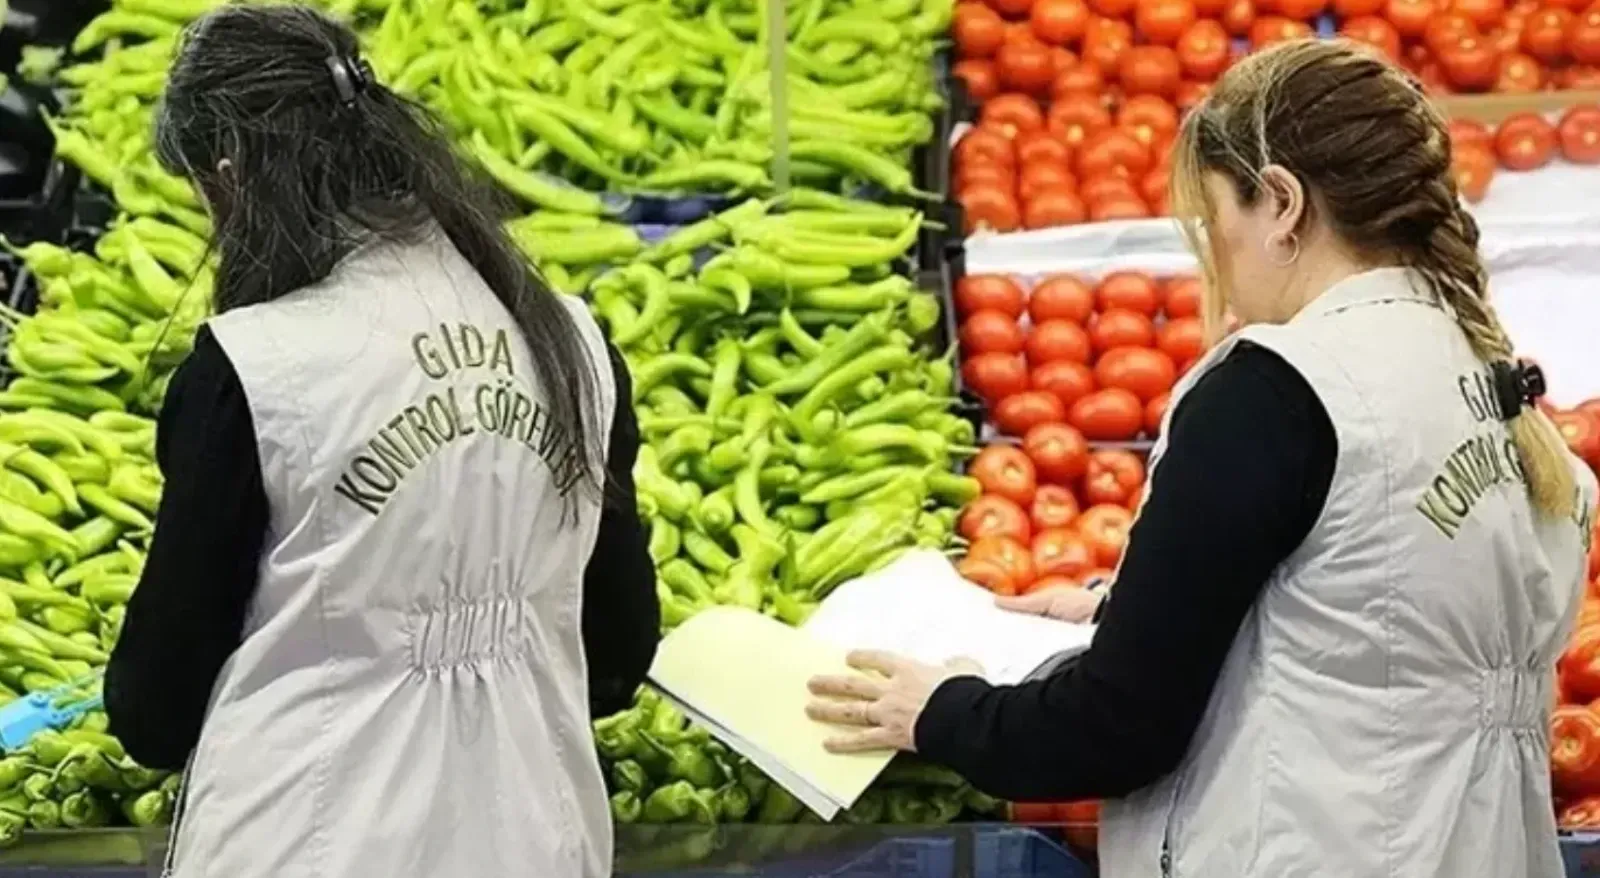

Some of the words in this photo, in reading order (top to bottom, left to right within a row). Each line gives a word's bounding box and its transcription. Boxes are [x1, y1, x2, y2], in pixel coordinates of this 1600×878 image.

[412, 322, 513, 379] GIDA
[1458, 371, 1504, 421] GID
[334, 386, 475, 516] KONTROL
